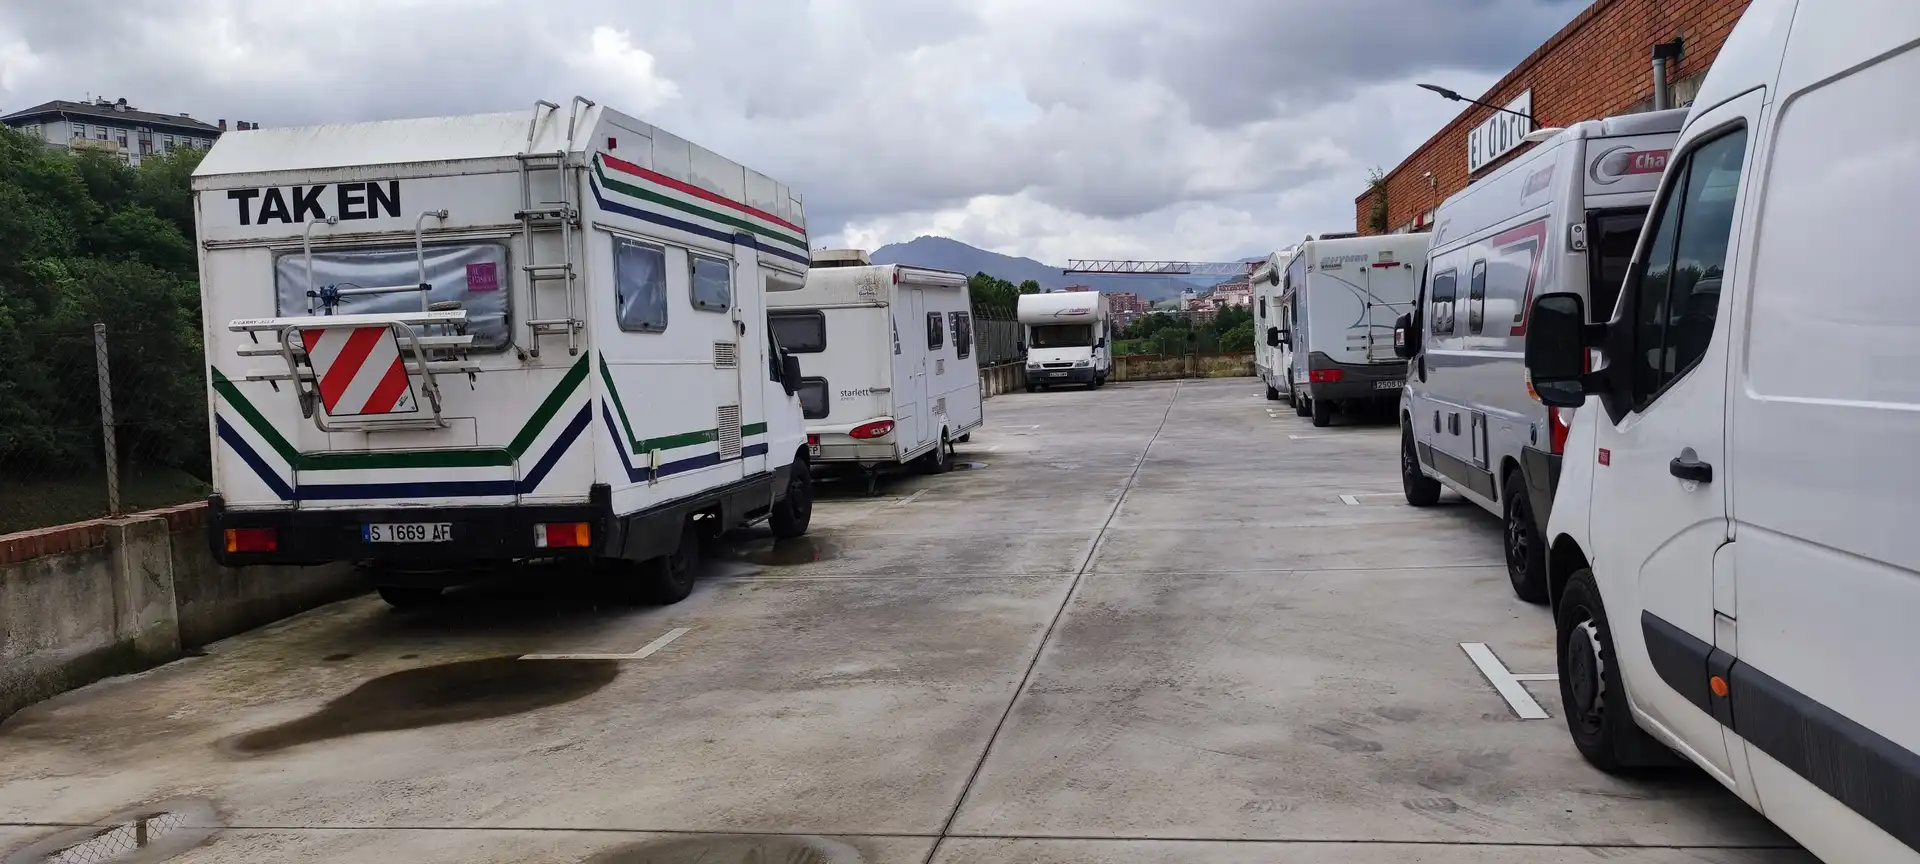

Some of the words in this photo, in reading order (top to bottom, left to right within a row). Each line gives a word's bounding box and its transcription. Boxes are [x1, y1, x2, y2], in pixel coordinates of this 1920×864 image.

[1472, 128, 1482, 169] El
[840, 389, 869, 397] starlett
[371, 525, 381, 541] S
[388, 524, 425, 541] 1669
[432, 524, 451, 541] AF
